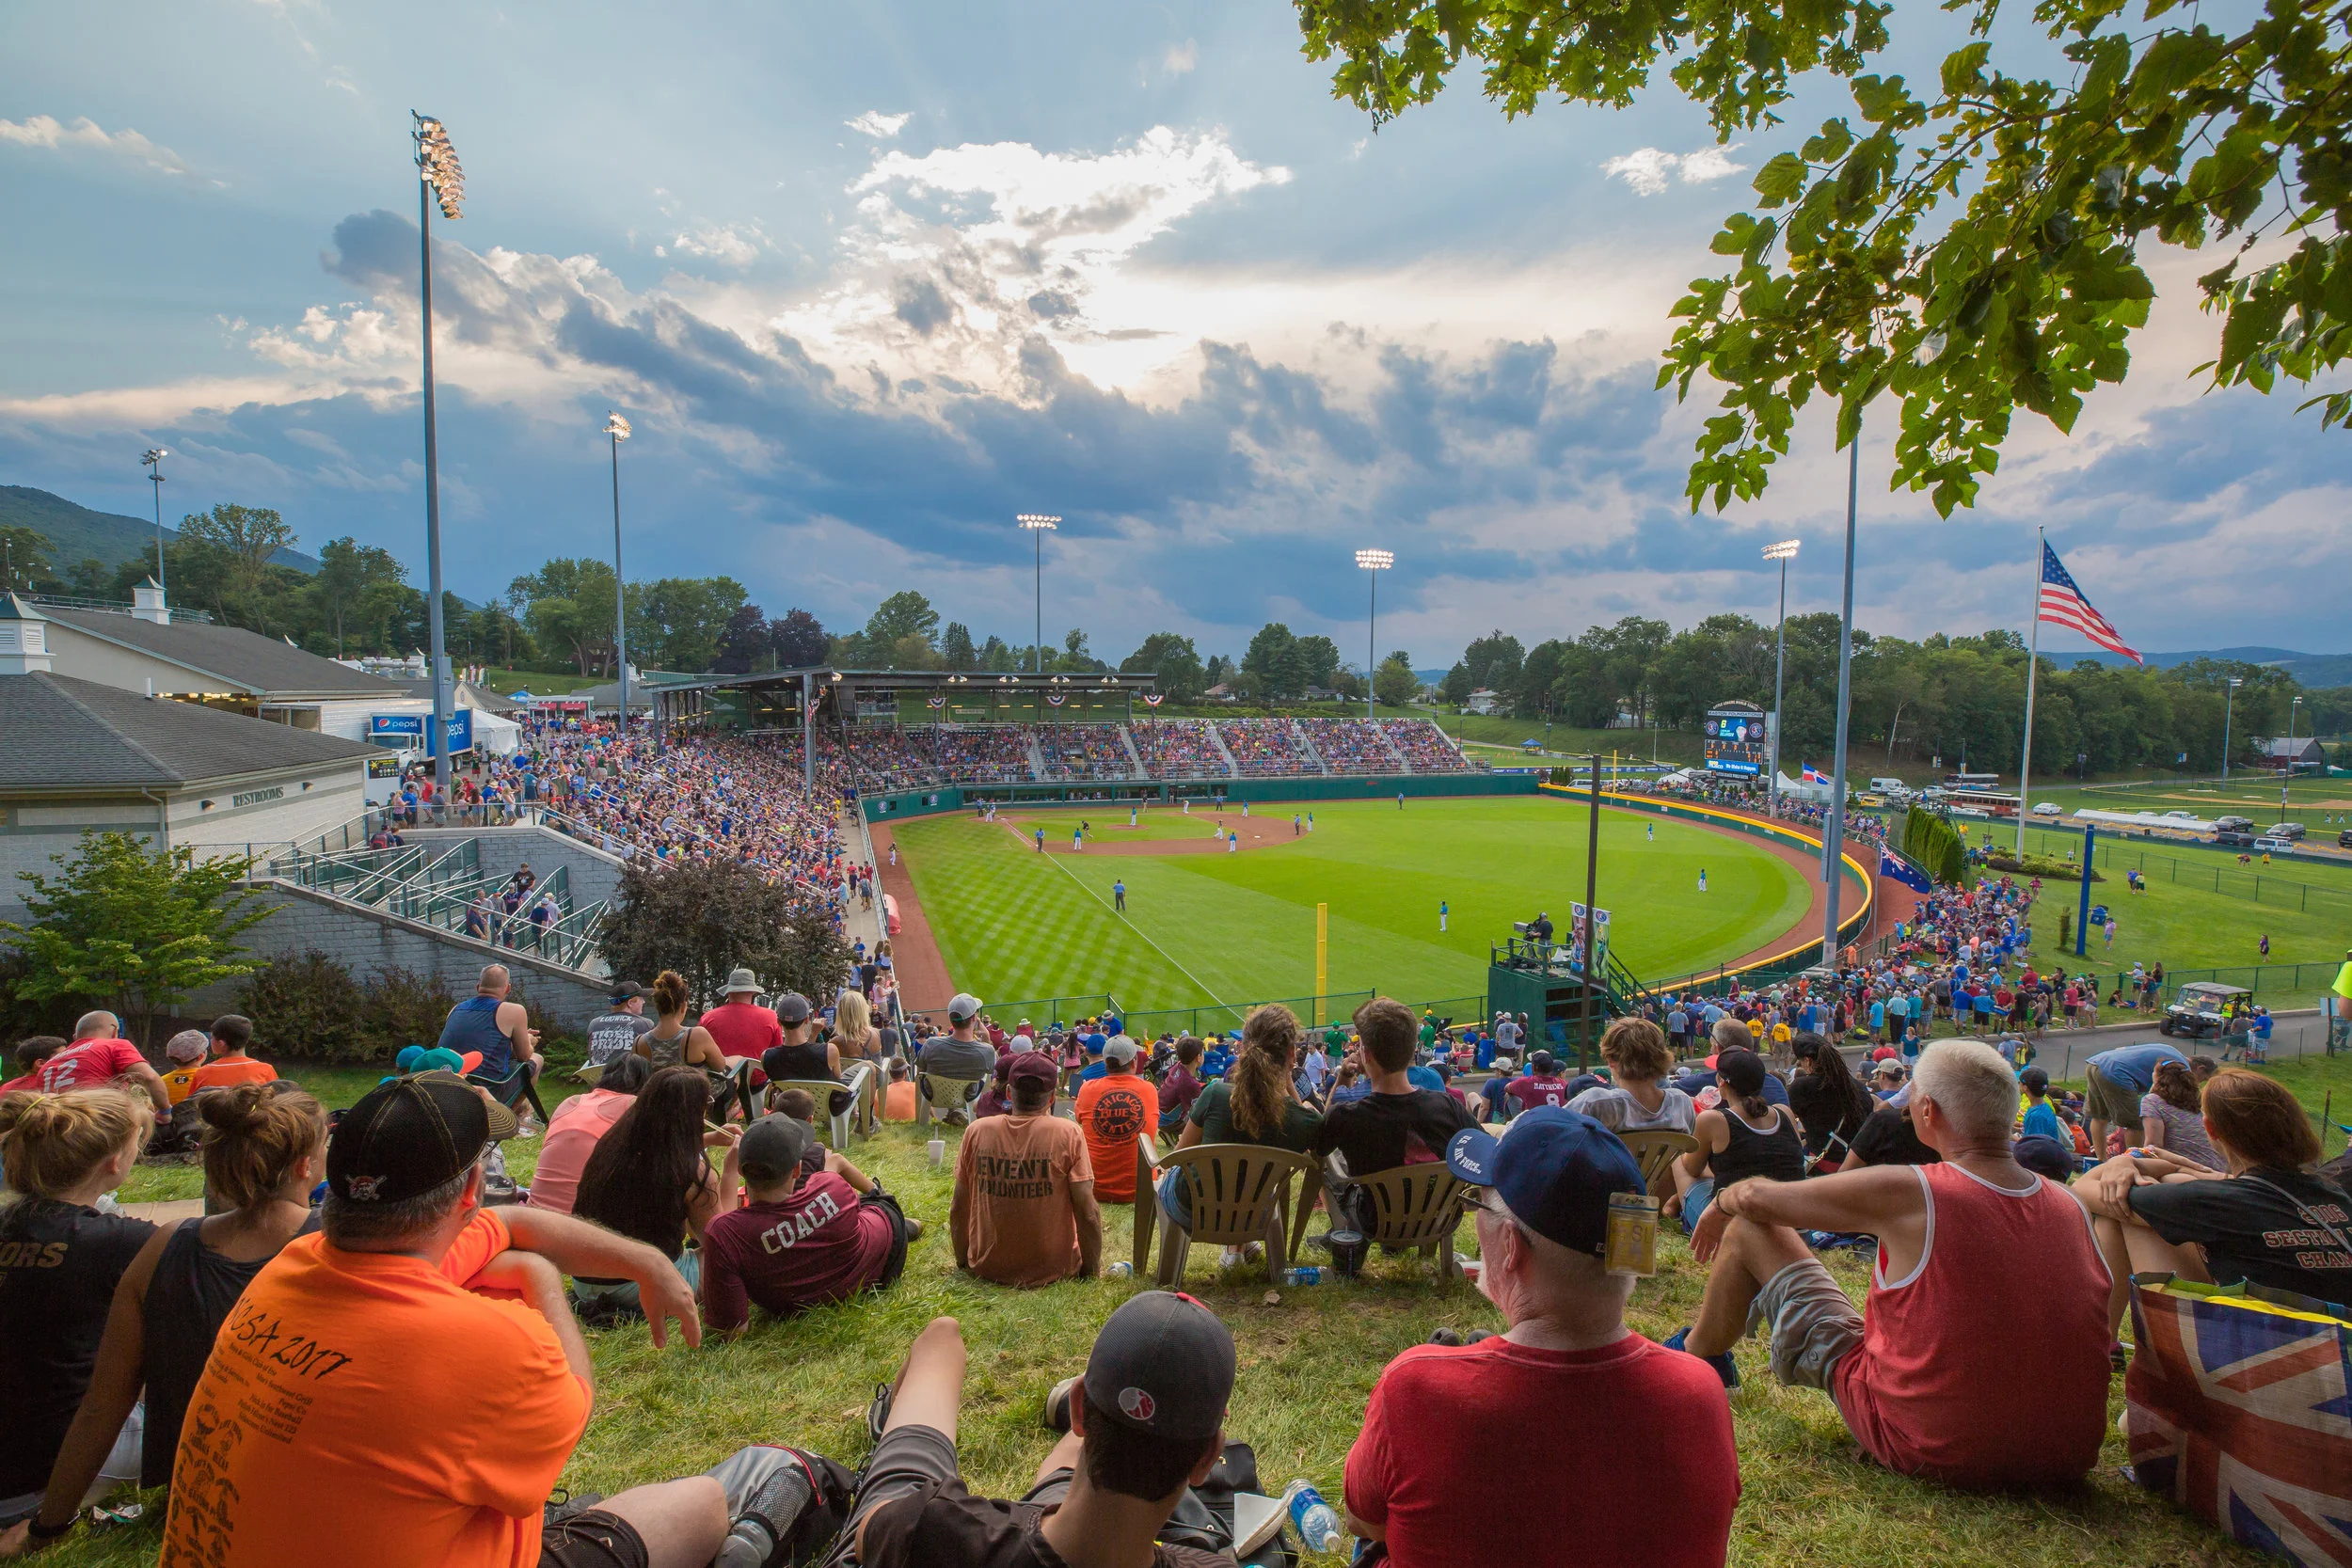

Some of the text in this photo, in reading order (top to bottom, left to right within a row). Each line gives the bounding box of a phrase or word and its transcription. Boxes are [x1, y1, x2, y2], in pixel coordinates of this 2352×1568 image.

[233, 786, 283, 807] RESTROOMS
[599, 1014, 632, 1022] LUDWICK
[592, 1030, 634, 1039] TIGER
[591, 1038, 633, 1051] PRIDE
[43, 1058, 78, 1093] 12
[1534, 1082, 1564, 1091] MATTHEWS
[1097, 1093, 1141, 1112] CHICAGO
[1097, 1116, 1140, 1133] CENTER
[1454, 1148, 1464, 1162] AIR
[977, 1156, 1051, 1180] EVENT
[1459, 1156, 1481, 1174] FORCE
[760, 1192, 839, 1255] COACH
[269, 1337, 353, 1381] 2017
